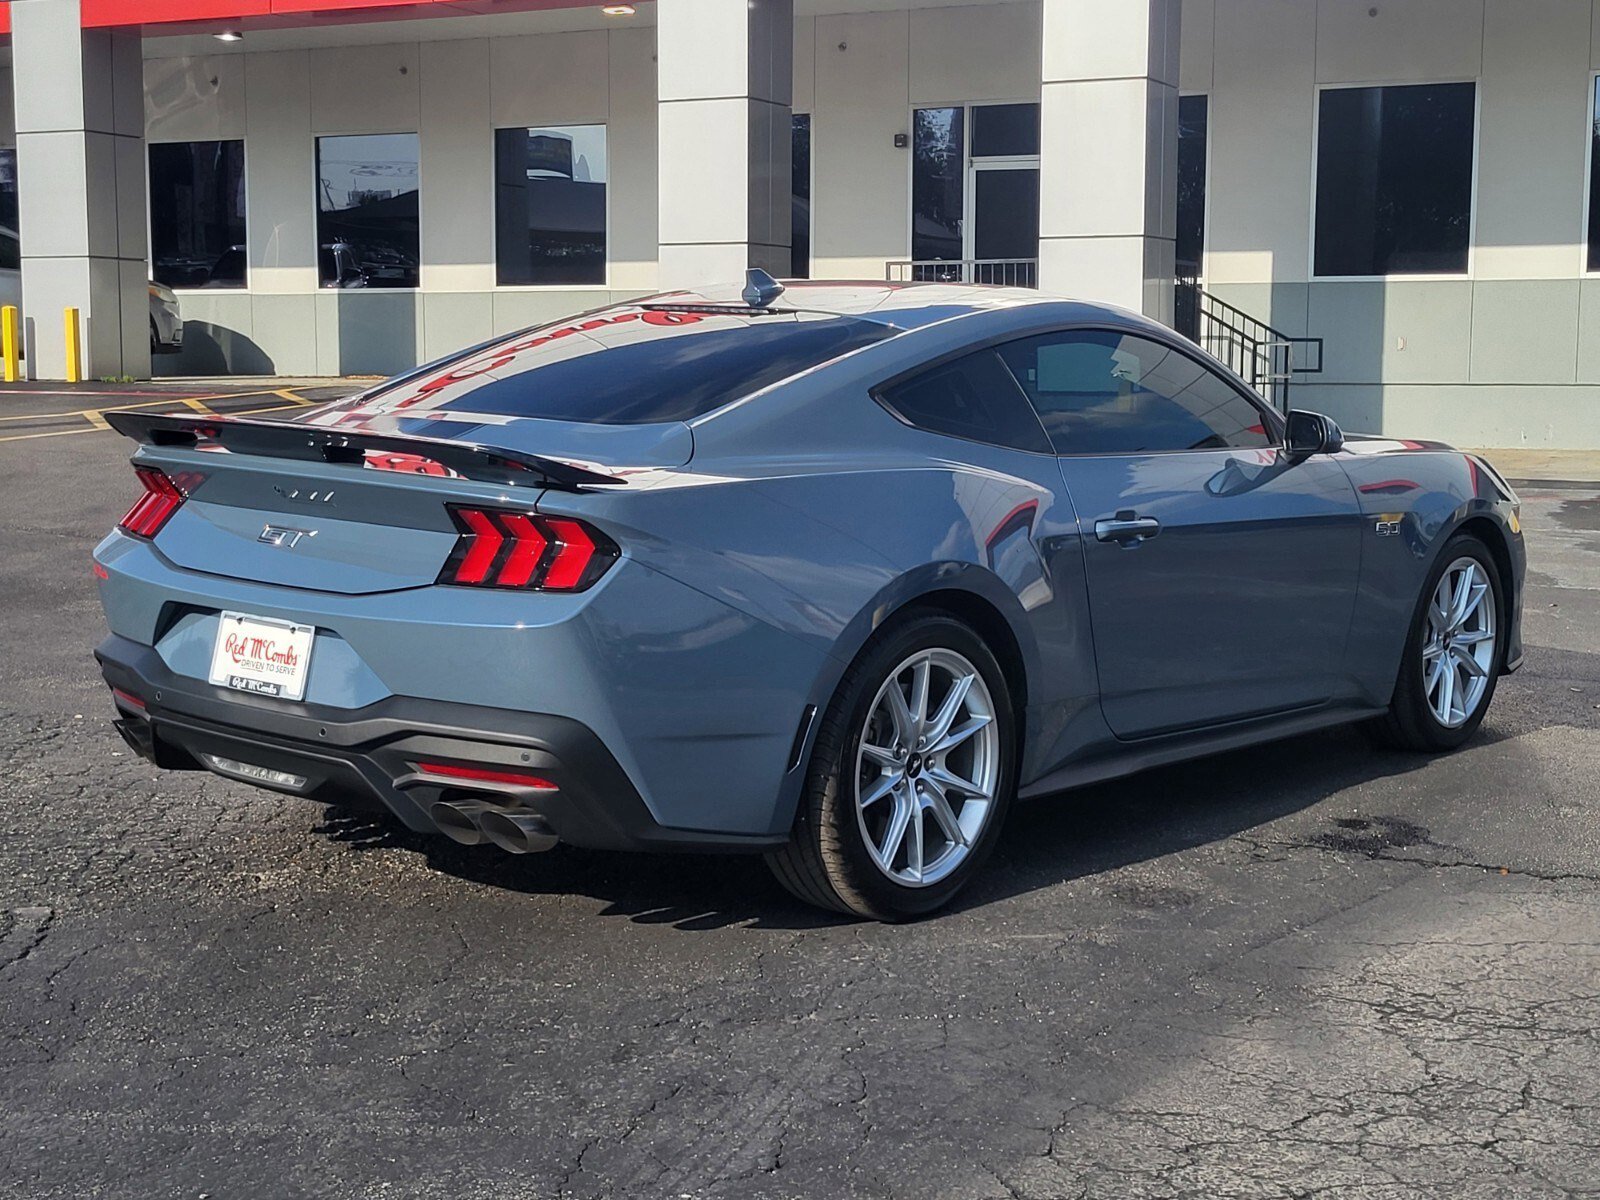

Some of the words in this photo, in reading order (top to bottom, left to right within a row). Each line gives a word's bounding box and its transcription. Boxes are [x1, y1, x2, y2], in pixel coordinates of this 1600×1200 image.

[257, 524, 319, 548] GT
[225, 632, 249, 664] Red
[250, 637, 298, 666] McCombs
[240, 659, 265, 671] DRIVEN
[265, 663, 275, 672] TO
[275, 664, 296, 676] SERVE
[232, 676, 248, 688] Red
